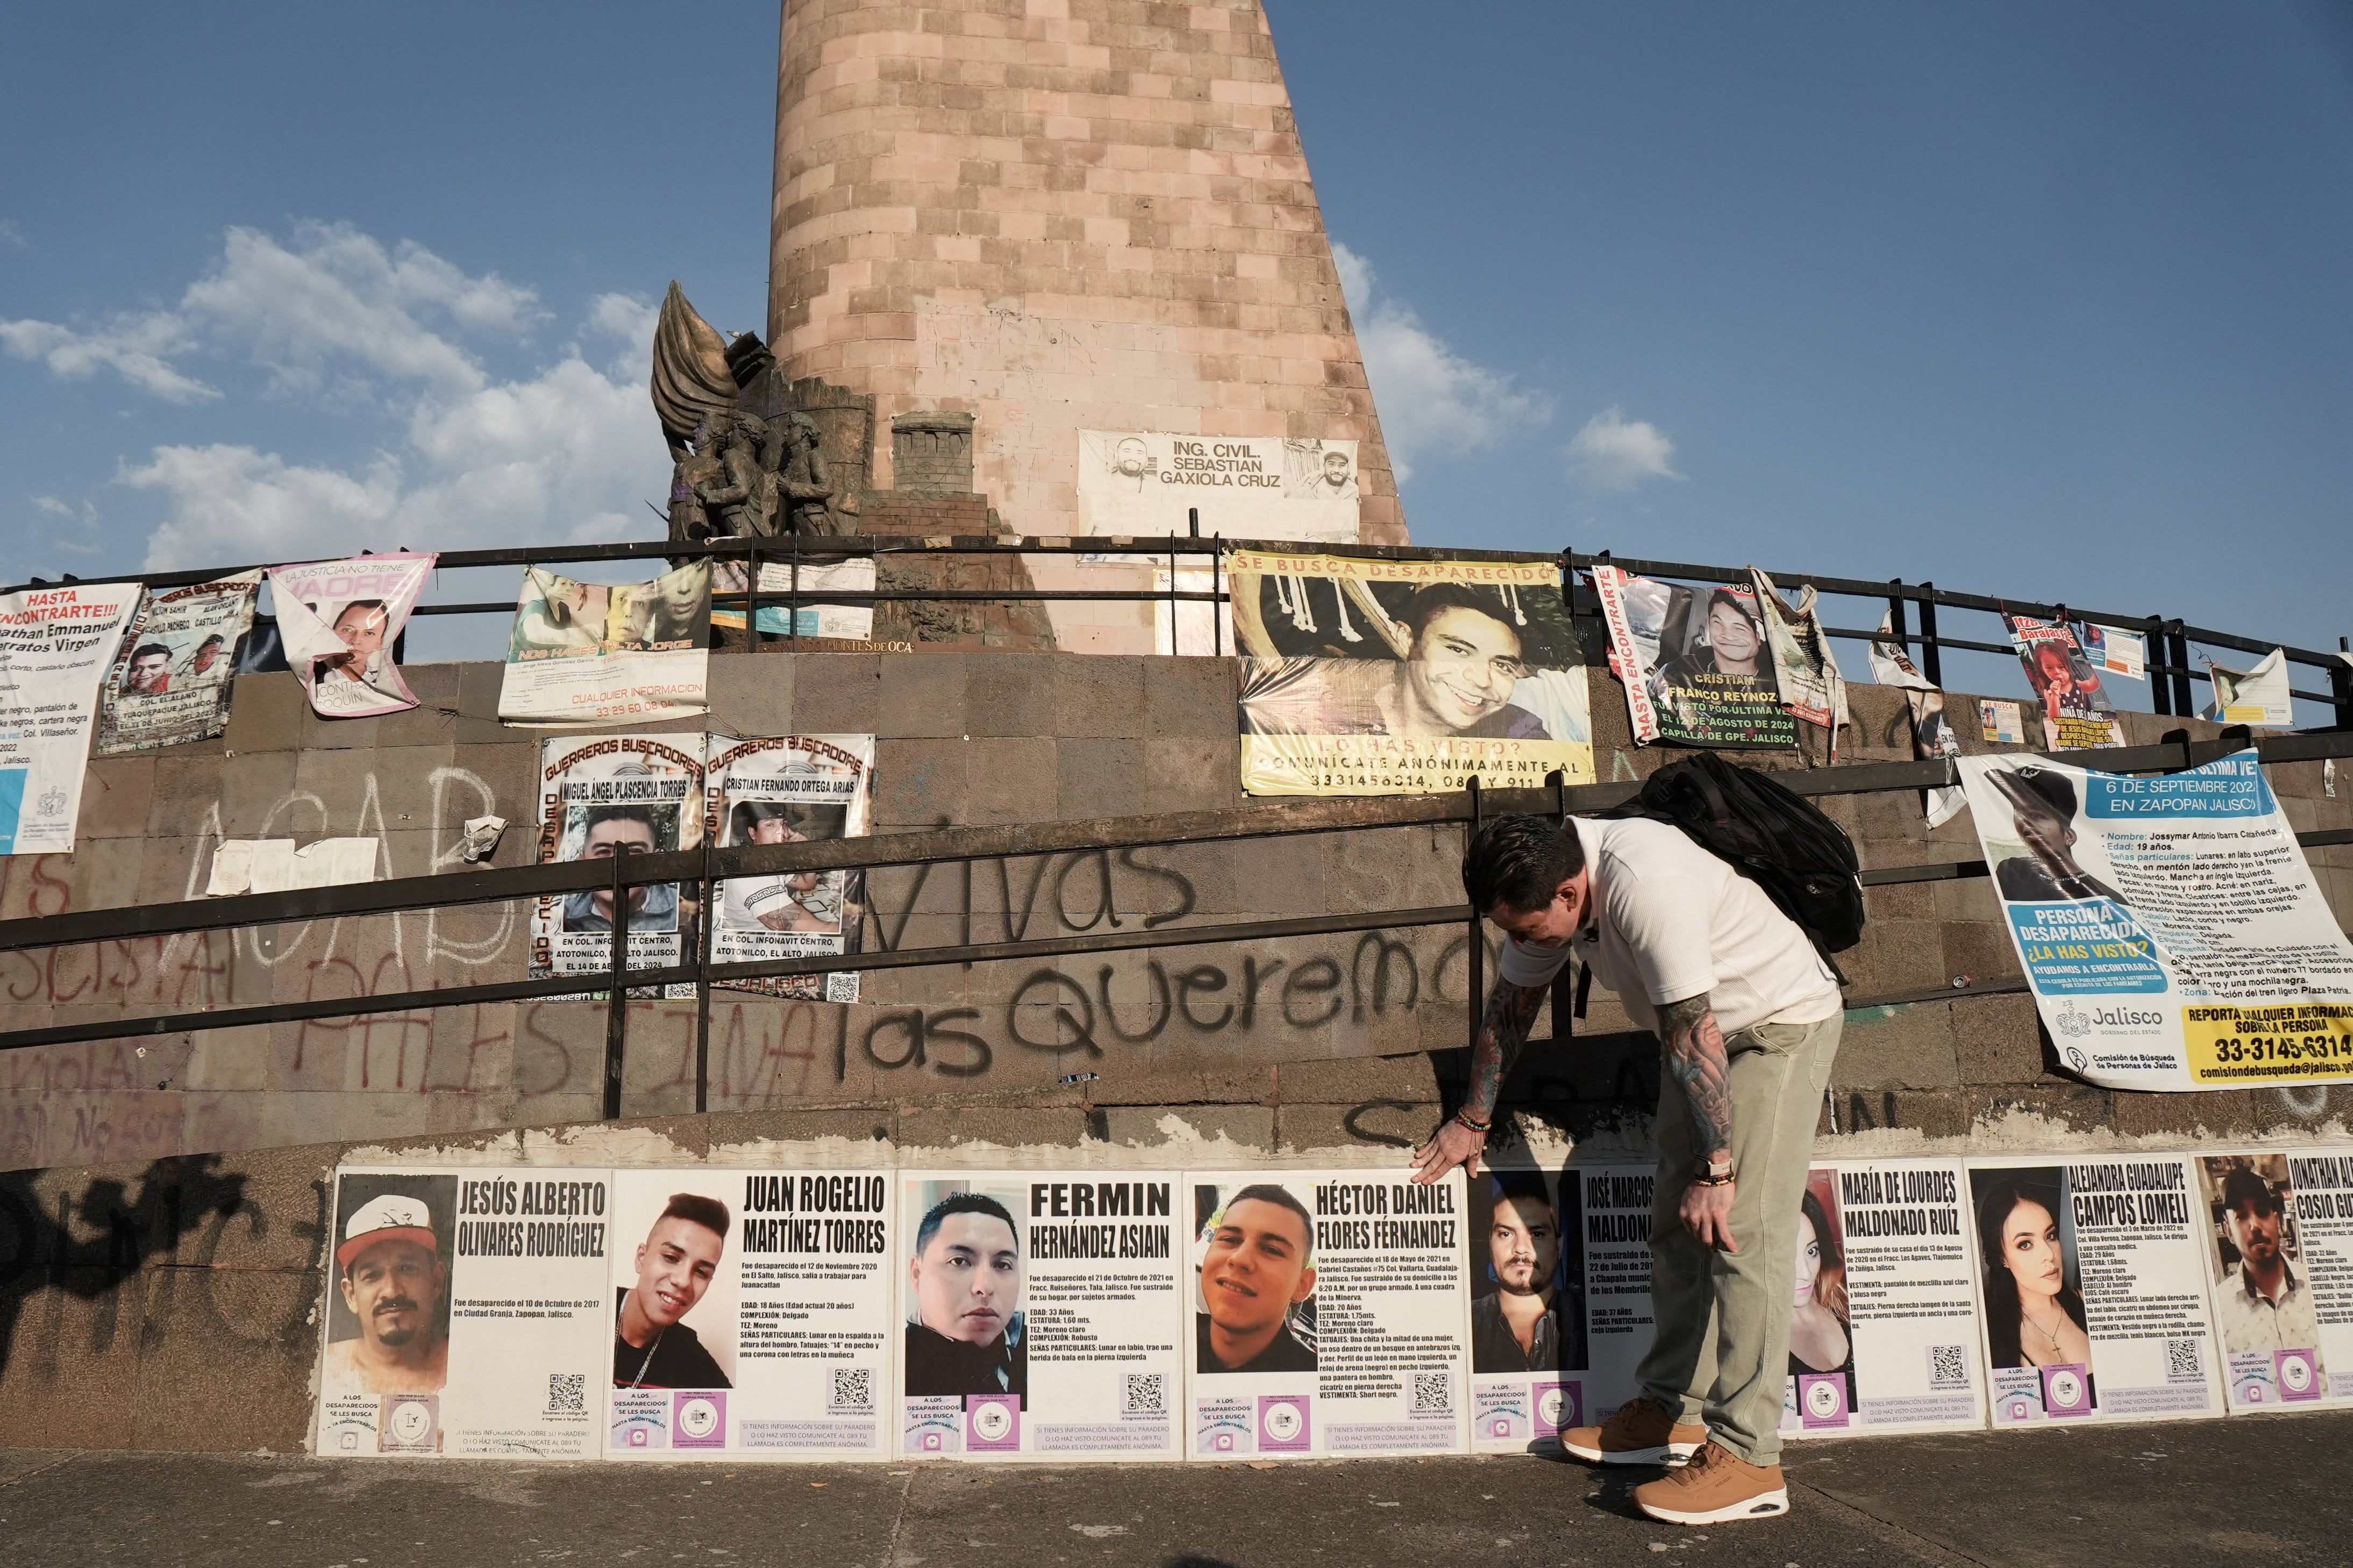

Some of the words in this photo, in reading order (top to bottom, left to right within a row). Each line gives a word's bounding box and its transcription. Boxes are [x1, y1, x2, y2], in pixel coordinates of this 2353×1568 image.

[1173, 441, 1208, 457] ING.
[1213, 443, 1261, 459] CIVIL.
[1174, 457, 1262, 472] SEBASTIAN
[1160, 471, 1232, 486] GAXIOLA
[1238, 474, 1281, 488] CRUZ
[286, 571, 297, 583] LA
[296, 566, 345, 579] JUSTICIA
[348, 565, 368, 574] NO
[372, 564, 405, 573] TIENE
[1237, 555, 1263, 570] SE
[1278, 560, 1358, 574] BUSCA
[1370, 563, 1551, 581] DESAPARECIDO
[27, 590, 77, 607] HASTA
[47, 616, 122, 638] Emmanuel
[1599, 570, 1638, 678] ENCONTRARTE
[2018, 628, 2062, 640] Barajas
[55, 637, 100, 652] Virgen
[518, 649, 548, 661] NOS
[551, 645, 597, 657] HACES
[601, 639, 643, 654] FALTA
[647, 639, 693, 650] JORGE
[827, 640, 872, 651] MONTES
[873, 642, 887, 652] DE
[1694, 674, 1755, 685] CRISTIAM
[572, 688, 628, 704] CUALQUIER
[631, 684, 702, 696] INFORMACION
[1668, 686, 1720, 701] FRANCO
[34, 704, 66, 714] pantalón
[596, 707, 609, 717] 33
[612, 705, 625, 715] 29
[628, 703, 641, 713] 60
[645, 700, 658, 711] 08
[1628, 683, 1651, 738] HASTA
[39, 716, 63, 725] cartera
[67, 715, 88, 725] negra
[1662, 713, 1673, 724] EL
[1691, 716, 1706, 726] DE
[1709, 717, 1752, 728] AGOSTO
[1755, 720, 1769, 728] DE
[1770, 720, 1794, 729] 2024
[23, 729, 36, 737] Col.
[40, 727, 78, 737] Villaseñor.
[1661, 727, 1705, 740] CAPILLA
[1707, 732, 1722, 741] DE
[1725, 732, 1749, 742] GPE.
[1752, 733, 1794, 743] JALISCO
[707, 737, 784, 775] GUERREROS
[1431, 740, 1522, 755] VISTO?
[545, 739, 619, 782] GUERREROS
[621, 739, 704, 779] BUSCADORES
[1258, 754, 1388, 770] COMUNÍCATE
[1397, 755, 1549, 772] ANÓNIMAMENTE
[1559, 762, 1579, 774] AL
[564, 783, 589, 800] MIGUEL
[591, 777, 614, 799] ÁNGEL
[615, 781, 658, 800] PLASCENCIA
[659, 779, 687, 798] TORRES
[726, 777, 759, 790] CRISTIAN
[761, 778, 800, 791] FERNANDO
[801, 780, 830, 792] ORTEGA
[832, 781, 854, 793] ARIAS
[1507, 777, 1534, 788] 911
[2106, 781, 2116, 793] 6
[2122, 781, 2145, 793] DE
[2150, 781, 2227, 793] SEPTIEMBRE
[2110, 799, 2135, 812] EN
[2139, 798, 2207, 811] ZAPOPAN
[2107, 833, 2147, 841] Nombre:
[2150, 832, 2190, 842] Jossymar
[2150, 843, 2174, 851] años.
[2034, 905, 2114, 925] PERSONA
[722, 935, 733, 943] EN
[736, 935, 753, 943] COL.
[755, 936, 798, 945] INFONAVIT
[800, 937, 835, 947] CENTRO,
[2020, 921, 2142, 942] DESAPARECIDA
[716, 947, 768, 957] ATOTONILCO,
[2028, 945, 2055, 962] ¿LA
[2057, 943, 2090, 960] HAS
[2091, 940, 2148, 958] VISTO?
[2033, 964, 2081, 975] AYUDANOS
[2083, 964, 2090, 974] A
[2092, 963, 2158, 974] ENCONTRARLA
[2092, 1006, 2163, 1025] Jalisco
[2283, 1019, 2329, 1033] PERSONA
[2140, 1053, 2175, 1063] Búsqueda
[2214, 1035, 2352, 1062] 33-3145-6314
[2153, 1062, 2177, 1070] Jalisco
[2068, 1164, 2126, 1193] ALEJANDRA
[2127, 1163, 2186, 1192] GUADALUPE
[2289, 1157, 2341, 1190] JONATHAN
[744, 1176, 795, 1212] JUAN
[800, 1176, 885, 1213] ROGELIO
[1587, 1171, 1610, 1209] JOSÉ
[1841, 1166, 1883, 1205] MARÍA
[1885, 1172, 1900, 1204] DE
[1902, 1170, 1956, 1204] LOURDES
[459, 1175, 518, 1215] JESÚS
[521, 1182, 607, 1216] ALBERTO
[1031, 1183, 1170, 1217] FERMIN
[1316, 1180, 1387, 1215] HÉCTOR
[1393, 1184, 1454, 1214] DANIEL
[2073, 1195, 2136, 1227] CAMPOS
[2140, 1193, 2189, 1225] LOMELI
[2296, 1194, 2334, 1220] COSIO
[1844, 1208, 1927, 1237] MALDONADO
[1930, 1204, 1960, 1235] RUÍZ
[458, 1221, 523, 1257] OLIVARES
[526, 1215, 605, 1258] RODRÍGUEZ
[743, 1213, 821, 1254] MARTÍNEZ
[824, 1219, 885, 1254] TORRES
[1030, 1219, 1116, 1259] HERNÁNDEZ
[1119, 1223, 1170, 1259] ASIAIN
[1317, 1220, 1370, 1249] FLORES
[1374, 1216, 1456, 1249] FÉRNANDEZ
[454, 1299, 467, 1307] Fue
[468, 1299, 516, 1309] desaparecido
[517, 1299, 524, 1307] el
[525, 1299, 533, 1307] 10
[534, 1300, 543, 1308] de
[545, 1300, 572, 1308] Octubre
[573, 1300, 582, 1308] de
[583, 1300, 599, 1308] 2017
[1378, 1391, 1398, 1400] negro.
